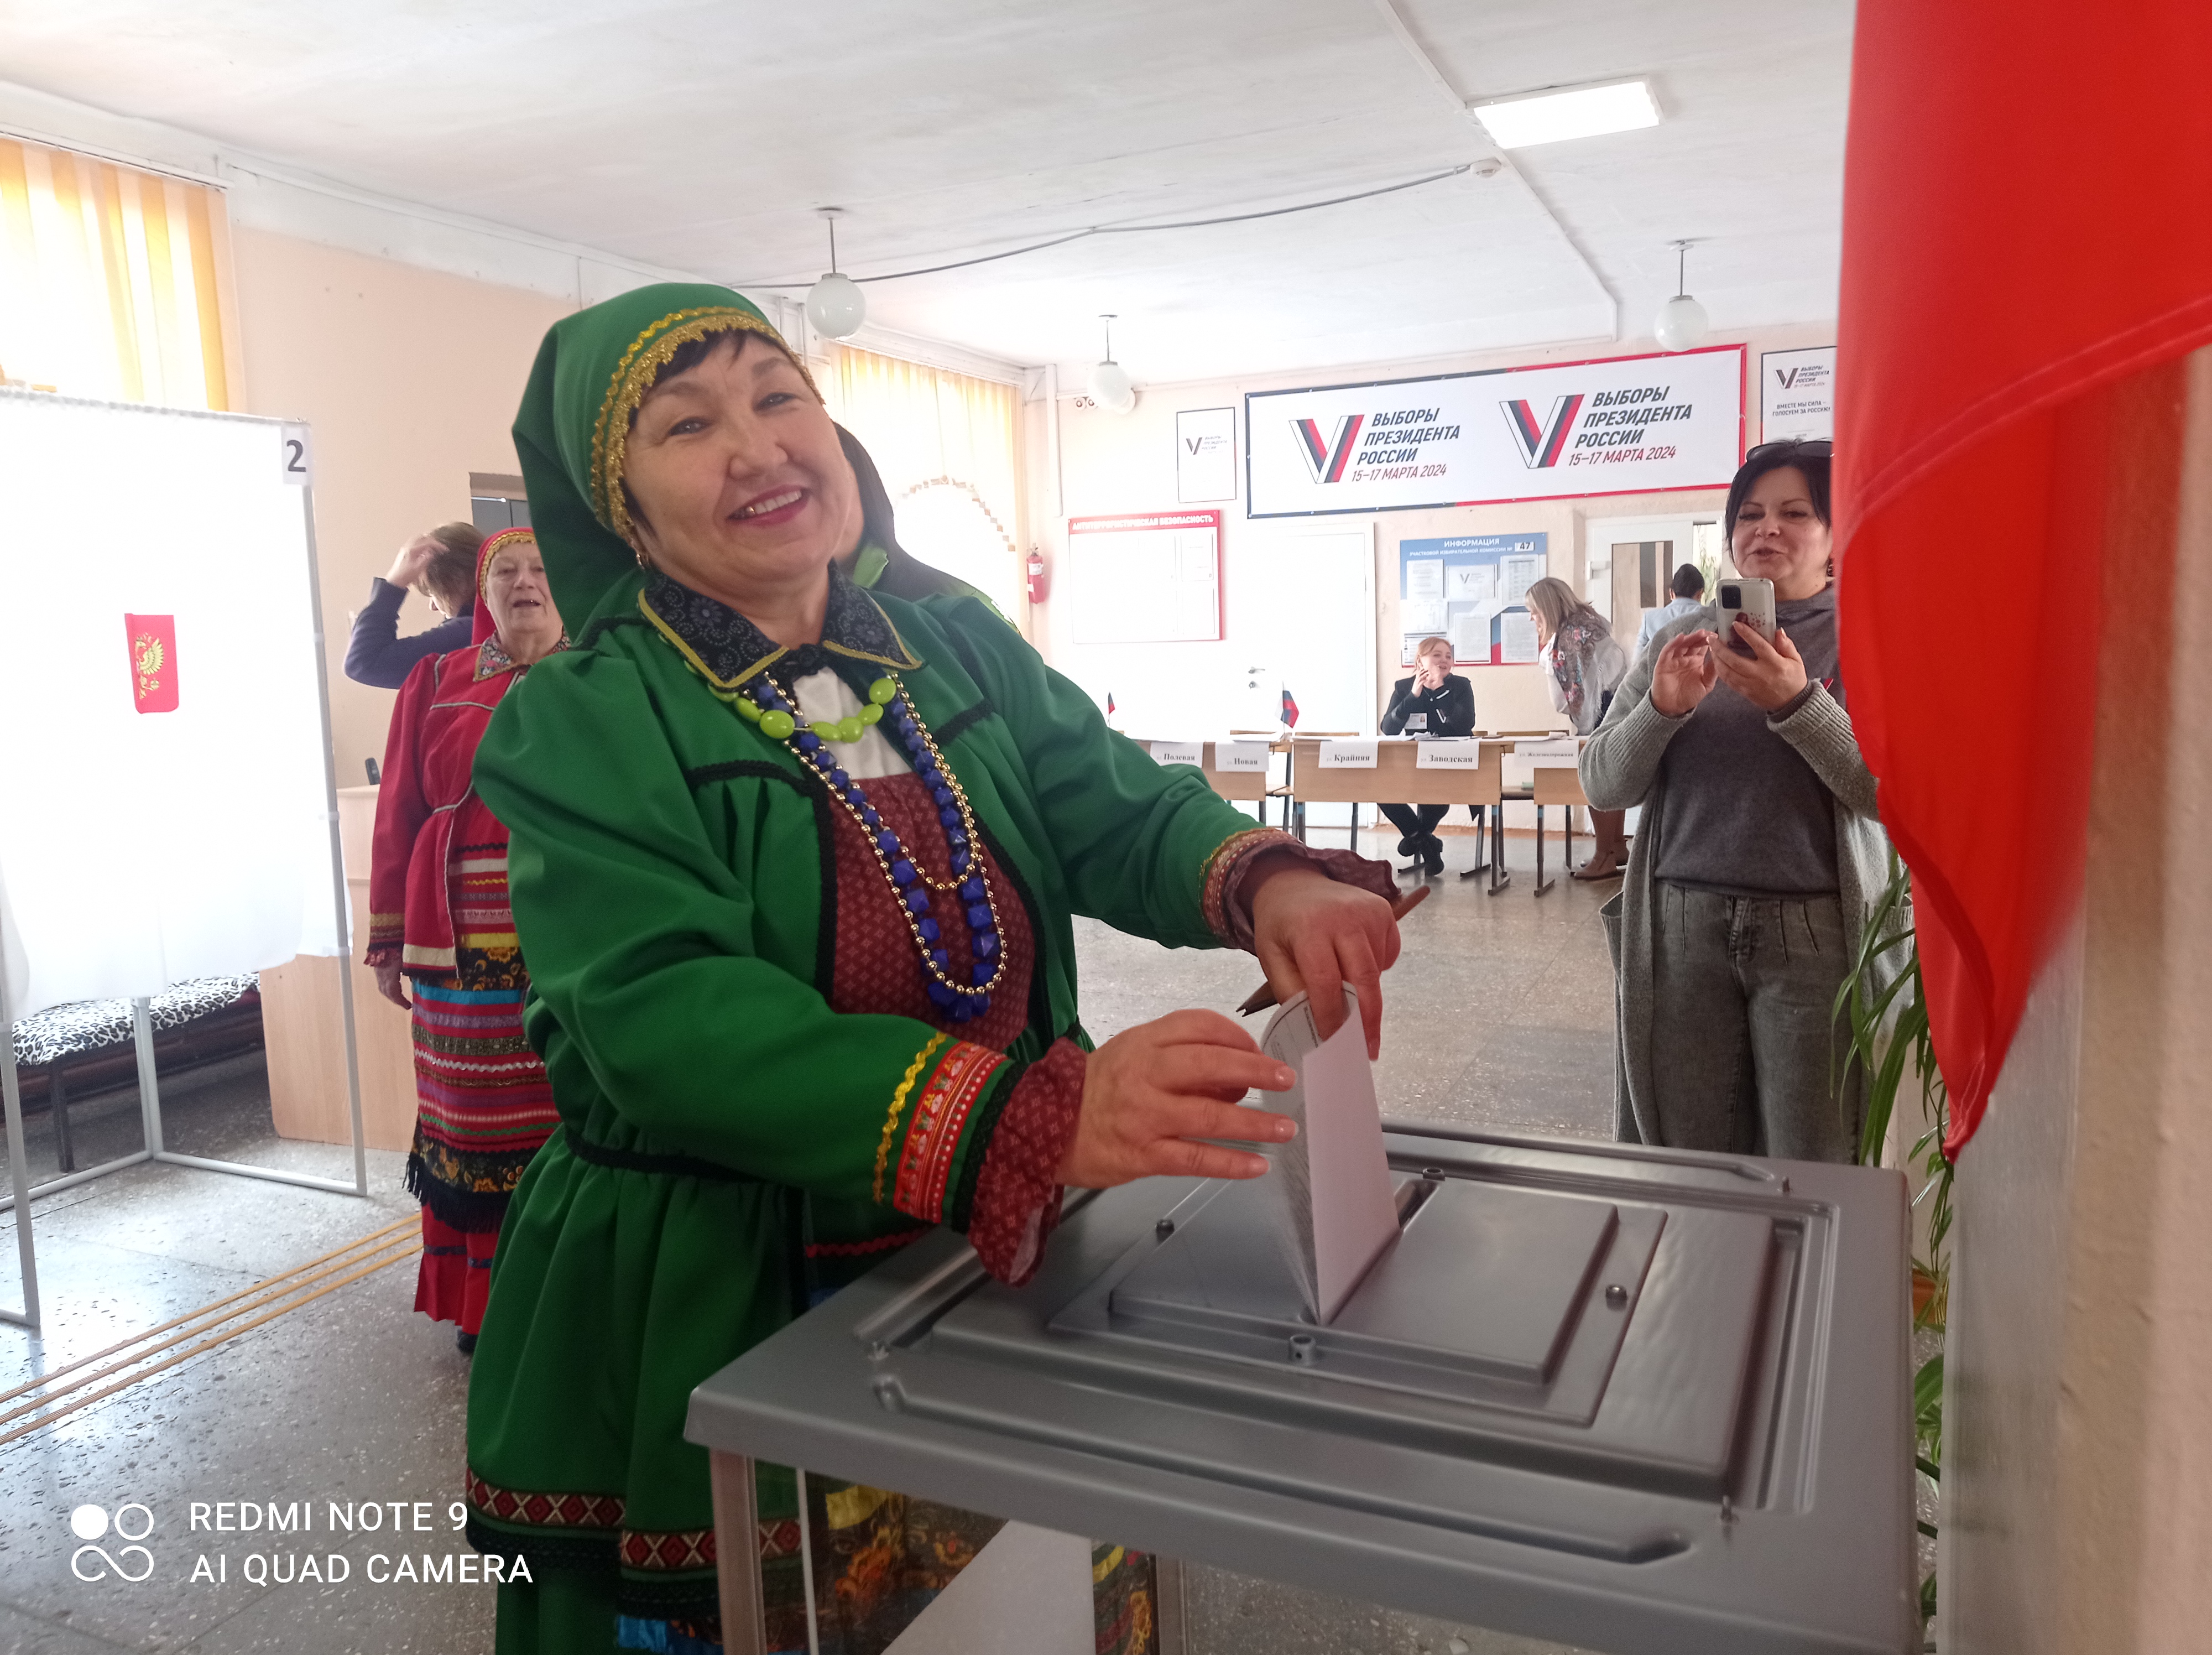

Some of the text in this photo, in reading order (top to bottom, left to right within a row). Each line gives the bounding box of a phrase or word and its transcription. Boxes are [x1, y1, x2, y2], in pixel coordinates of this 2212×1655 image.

[1592, 386, 1671, 407] ВЫБОРЫ
[1371, 408, 1440, 427] ВЫБОРЫ
[1583, 404, 1693, 428] ПРЕЗИДЕНТА
[1364, 425, 1460, 446] ПРЕЗИДЕНТА
[1575, 429, 1645, 449] РОССИИ
[286, 440, 306, 472] 2
[1357, 447, 1418, 466] РОССИИ
[1603, 448, 1644, 464] МАРТА
[1646, 445, 1676, 461] 2024
[1381, 466, 1419, 480] МАРТА
[1420, 464, 1447, 477] 2024
[1444, 538, 1500, 548] ИНФОРМАЦИЯ
[1334, 754, 1370, 763] Крайняя
[1428, 754, 1473, 763] Заводская
